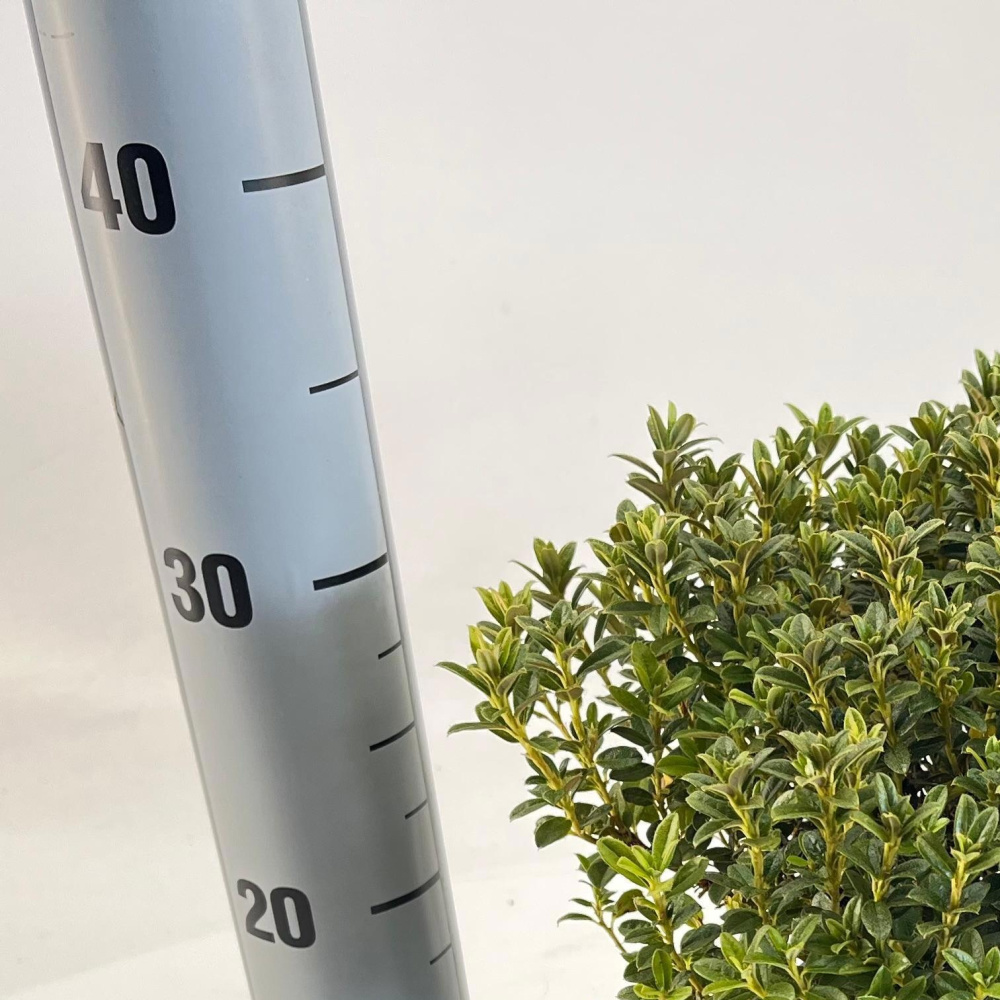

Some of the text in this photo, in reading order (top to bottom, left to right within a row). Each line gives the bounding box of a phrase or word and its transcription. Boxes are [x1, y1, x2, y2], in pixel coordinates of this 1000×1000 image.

[80, 142, 177, 236] 40
[163, 547, 253, 629] 30
[237, 878, 316, 948] 20
